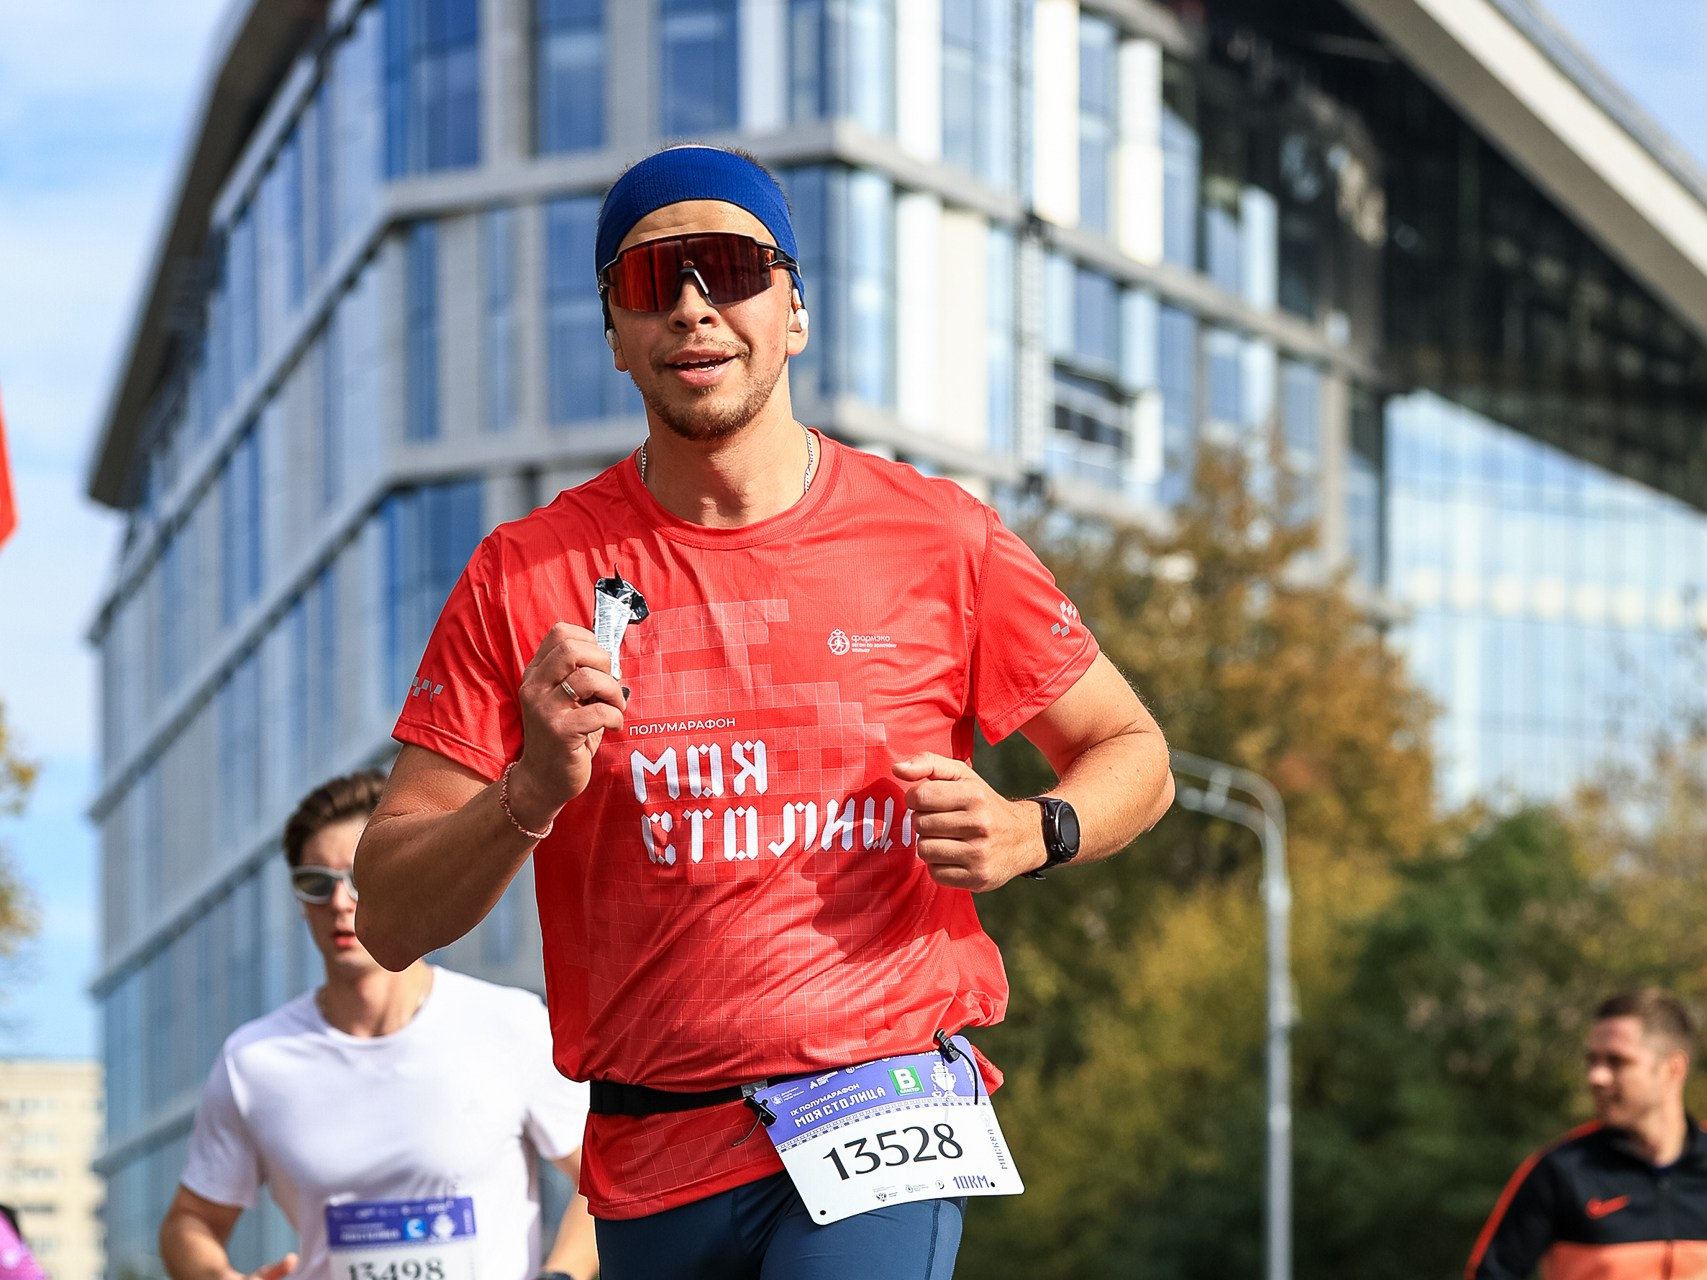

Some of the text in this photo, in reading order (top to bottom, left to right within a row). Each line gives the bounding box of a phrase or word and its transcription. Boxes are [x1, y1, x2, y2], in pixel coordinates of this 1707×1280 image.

[629, 717, 736, 736] ПОЛУМАРАФОН
[630, 739, 768, 804] МОЯ
[794, 1108, 823, 1128] МОЯ
[822, 1086, 887, 1116] СТОЛИЦА
[799, 1083, 860, 1112] ПОЛУМАРАФОН
[823, 1123, 963, 1180] 13528
